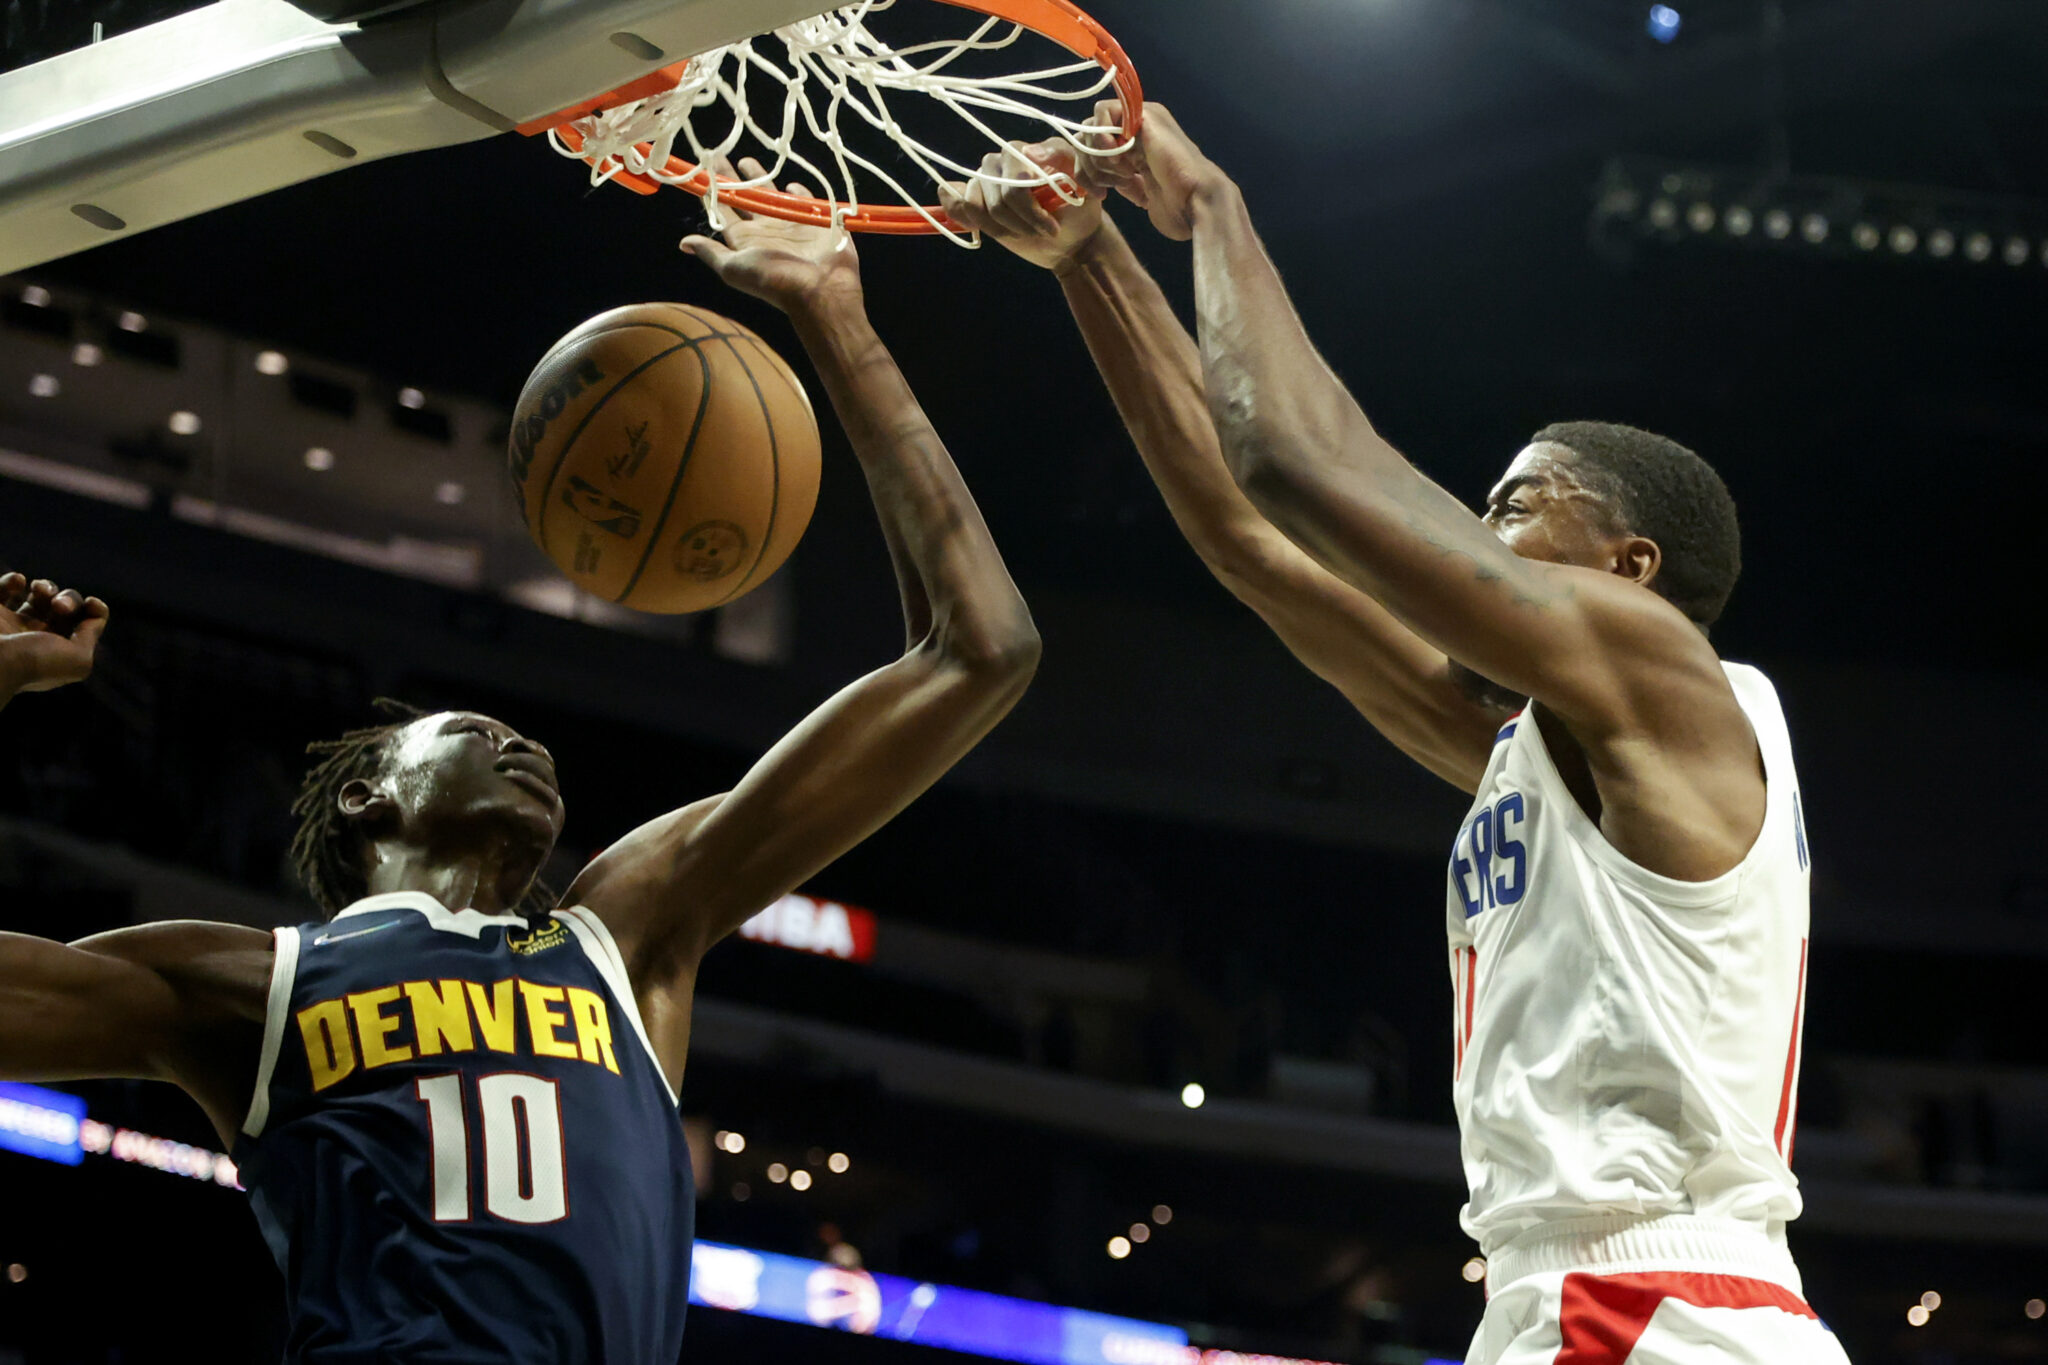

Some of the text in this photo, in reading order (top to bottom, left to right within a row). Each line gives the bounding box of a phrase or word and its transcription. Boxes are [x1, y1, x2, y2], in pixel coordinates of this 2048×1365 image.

[1451, 791, 1526, 919] ERS
[296, 976, 621, 1093] DENVER
[414, 1070, 570, 1225] 10
